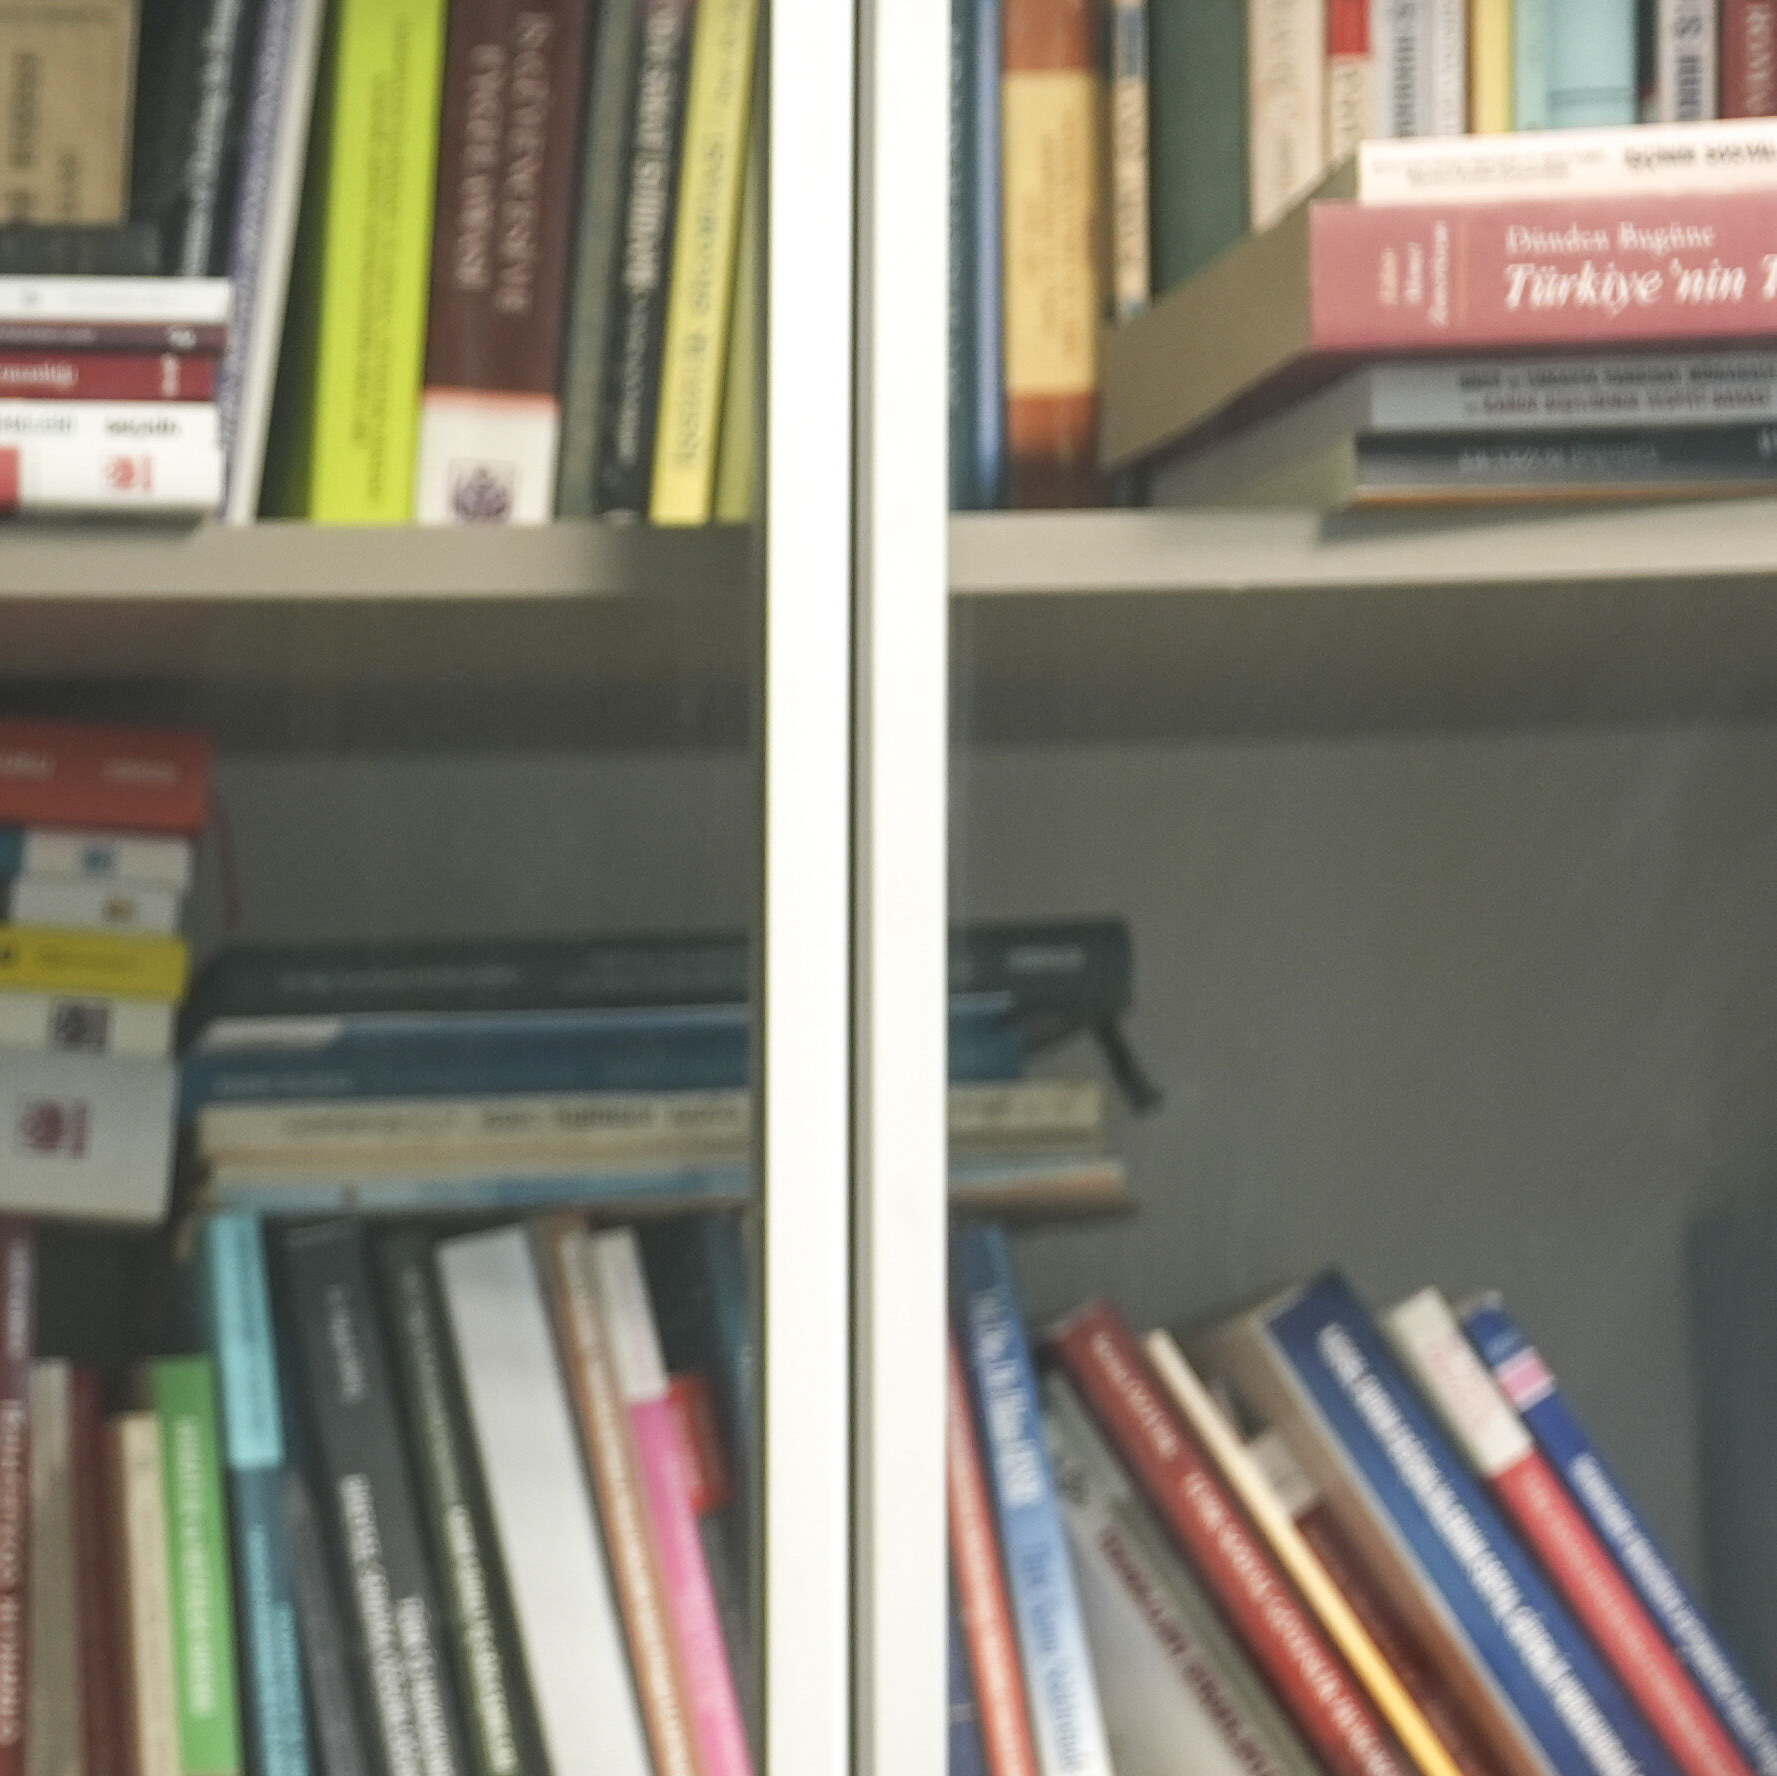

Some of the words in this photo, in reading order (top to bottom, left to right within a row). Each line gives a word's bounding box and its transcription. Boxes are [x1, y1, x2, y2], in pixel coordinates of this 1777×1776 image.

[1505, 222, 1609, 256] Dünden
[1618, 221, 1718, 259] Bugüne
[1502, 253, 1746, 319] Türkiye'nin
